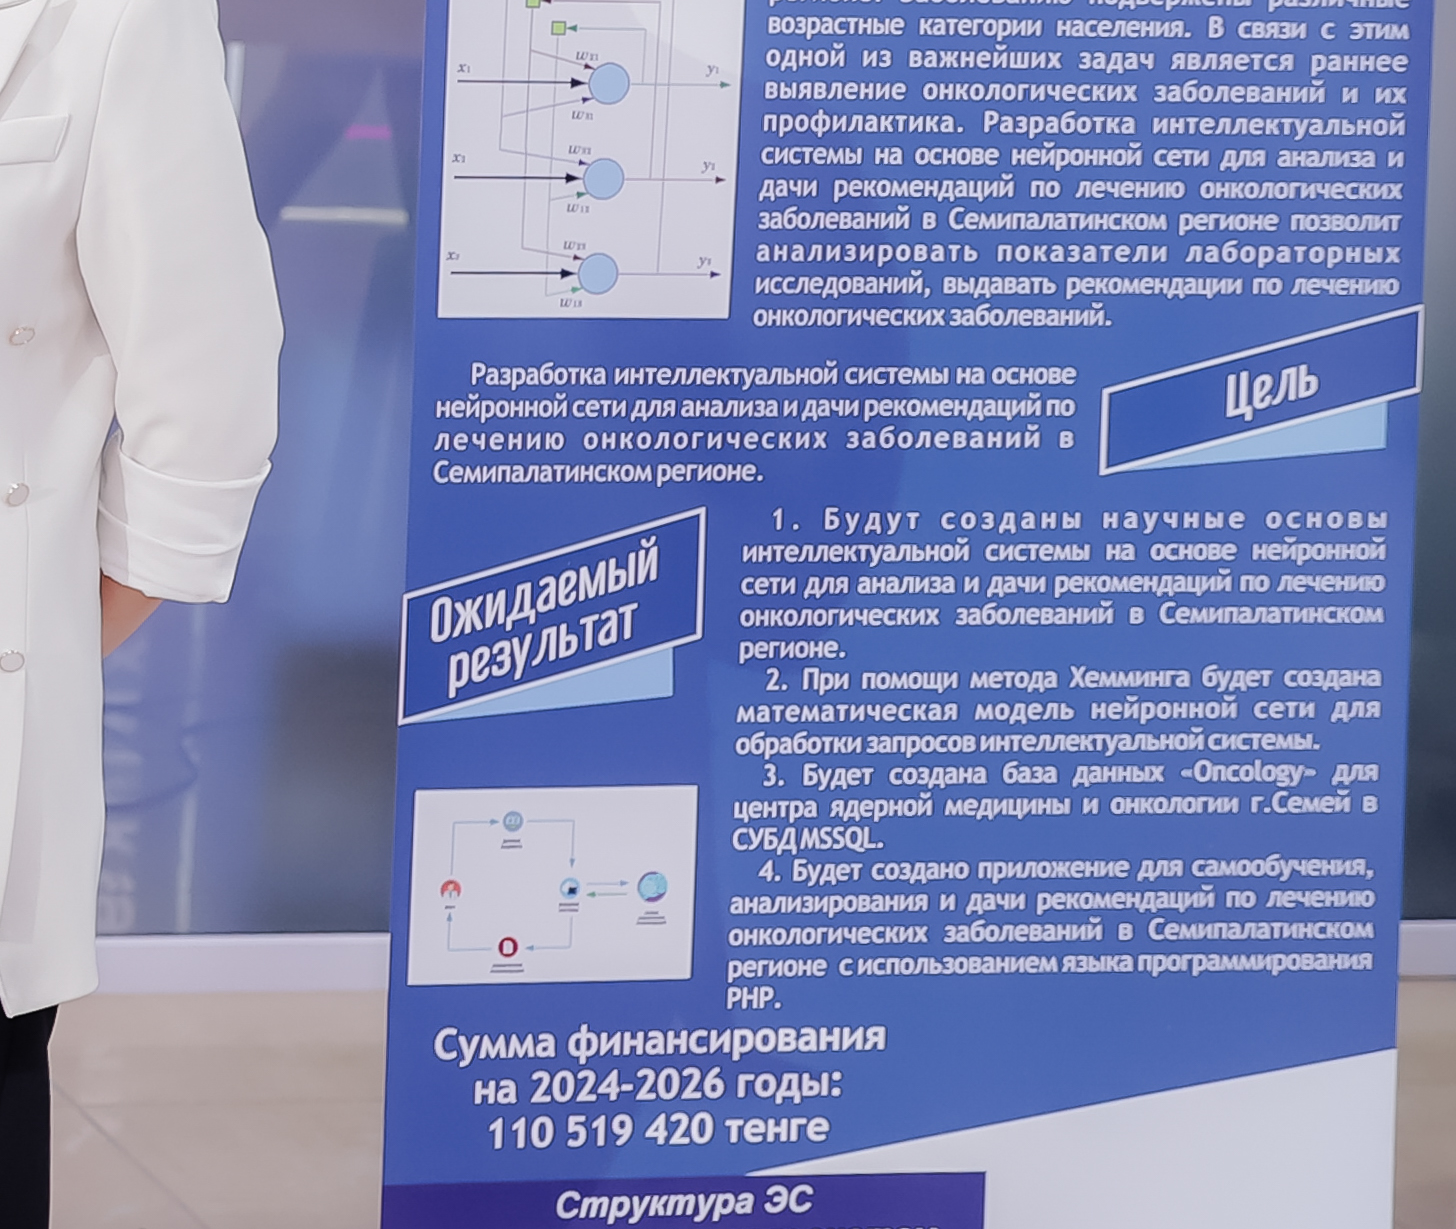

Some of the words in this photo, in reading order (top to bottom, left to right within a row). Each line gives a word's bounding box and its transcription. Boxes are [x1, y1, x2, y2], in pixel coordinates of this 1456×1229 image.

[754, 309, 945, 326] онкологических
[950, 303, 1111, 326] заболеваний.
[472, 362, 606, 390] Разработка
[615, 361, 837, 390] интеллектуальной
[845, 367, 948, 384] системы
[957, 367, 984, 384] на
[992, 367, 1076, 384] основе
[437, 393, 567, 423] нейронной
[573, 400, 626, 417] сети
[631, 400, 675, 421] для
[681, 400, 778, 417] анализа
[784, 400, 798, 416] и
[802, 399, 859, 421] дачи
[864, 393, 1041, 421] рекомендаций
[1046, 399, 1075, 416] по
[1225, 363, 1320, 422] Цель
[435, 433, 564, 450] лечению
[584, 432, 826, 449] онкологических
[847, 424, 1039, 448] заболеваний
[1060, 431, 1073, 448] в
[434, 460, 652, 483] Семипалатинском
[657, 464, 763, 487] регионе.
[429, 535, 659, 643] Ожидаемый
[446, 600, 639, 698] результат
[766, 668, 787, 690] 2.
[803, 668, 849, 695] При
[862, 672, 958, 693] помощи
[970, 671, 1057, 692] метода
[1070, 666, 1190, 687] Хемминга
[1202, 665, 1273, 692] будет
[1284, 670, 1381, 691] создана
[733, 827, 797, 855] СУБД
[800, 826, 883, 852] MSSQL.
[759, 860, 780, 881] 4.
[793, 859, 862, 886] Будет
[872, 862, 969, 883] создано
[978, 861, 1130, 884] приложение
[1137, 860, 1183, 881] для
[1192, 854, 1373, 881] самообучения,
[727, 987, 780, 1009] PHP.
[435, 1028, 555, 1067] Сумма
[568, 1024, 885, 1064] финансирования
[475, 1080, 516, 1104] на
[531, 1067, 724, 1102] 2024-2026
[738, 1072, 841, 1104] годы:
[490, 1116, 553, 1149] 110
[568, 1114, 632, 1147] 519
[645, 1112, 713, 1144] 420
[725, 1117, 829, 1142] тенге
[557, 1191, 754, 1224] Структура
[764, 1185, 813, 1213] ЭС
